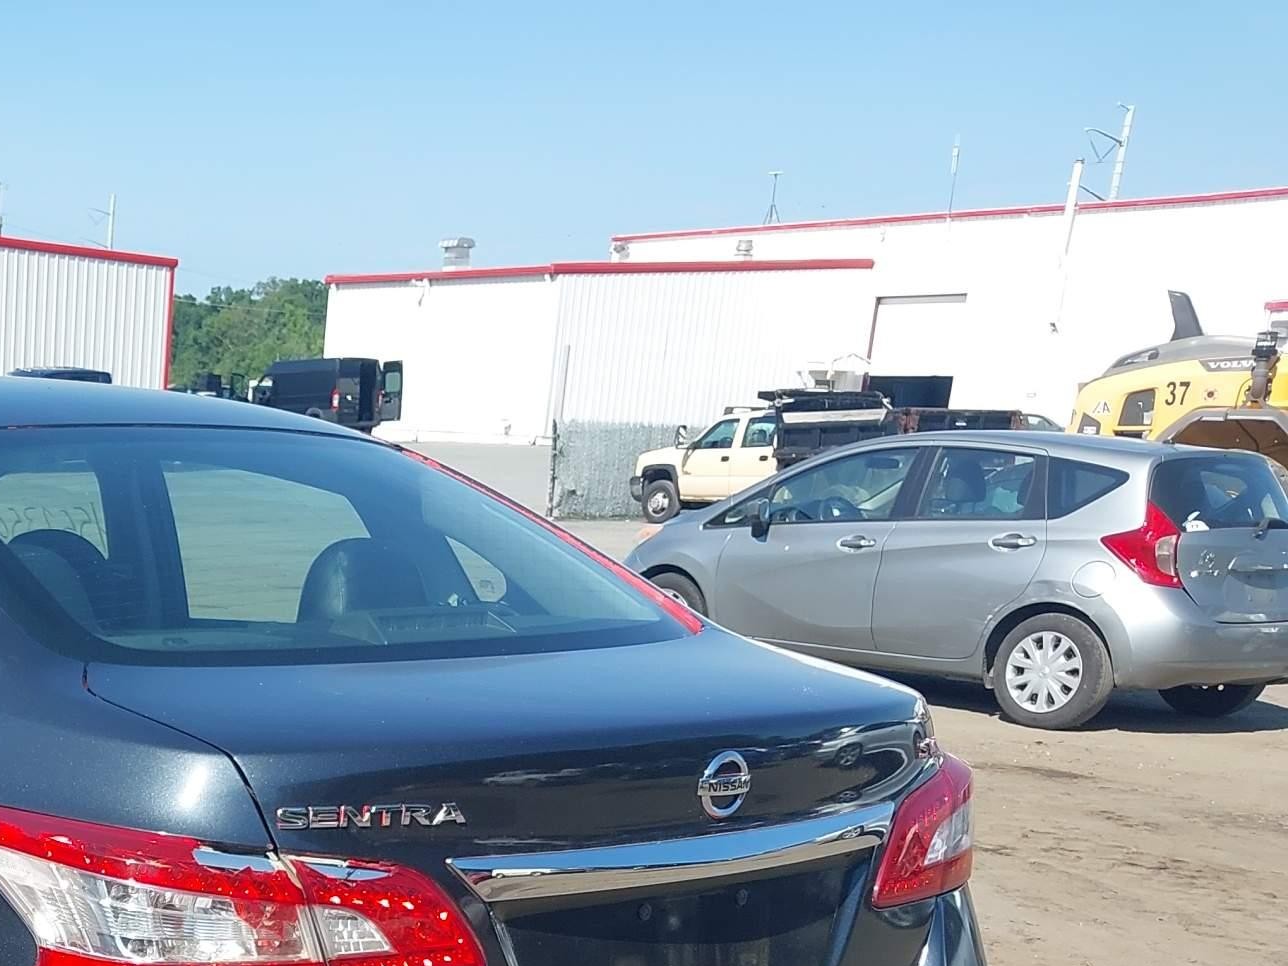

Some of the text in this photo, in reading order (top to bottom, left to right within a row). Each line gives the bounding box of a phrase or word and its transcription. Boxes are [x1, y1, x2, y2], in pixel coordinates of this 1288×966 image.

[1165, 381, 1191, 406] 37
[708, 778, 750, 793] NISSAN
[276, 802, 466, 830] SENTRA
